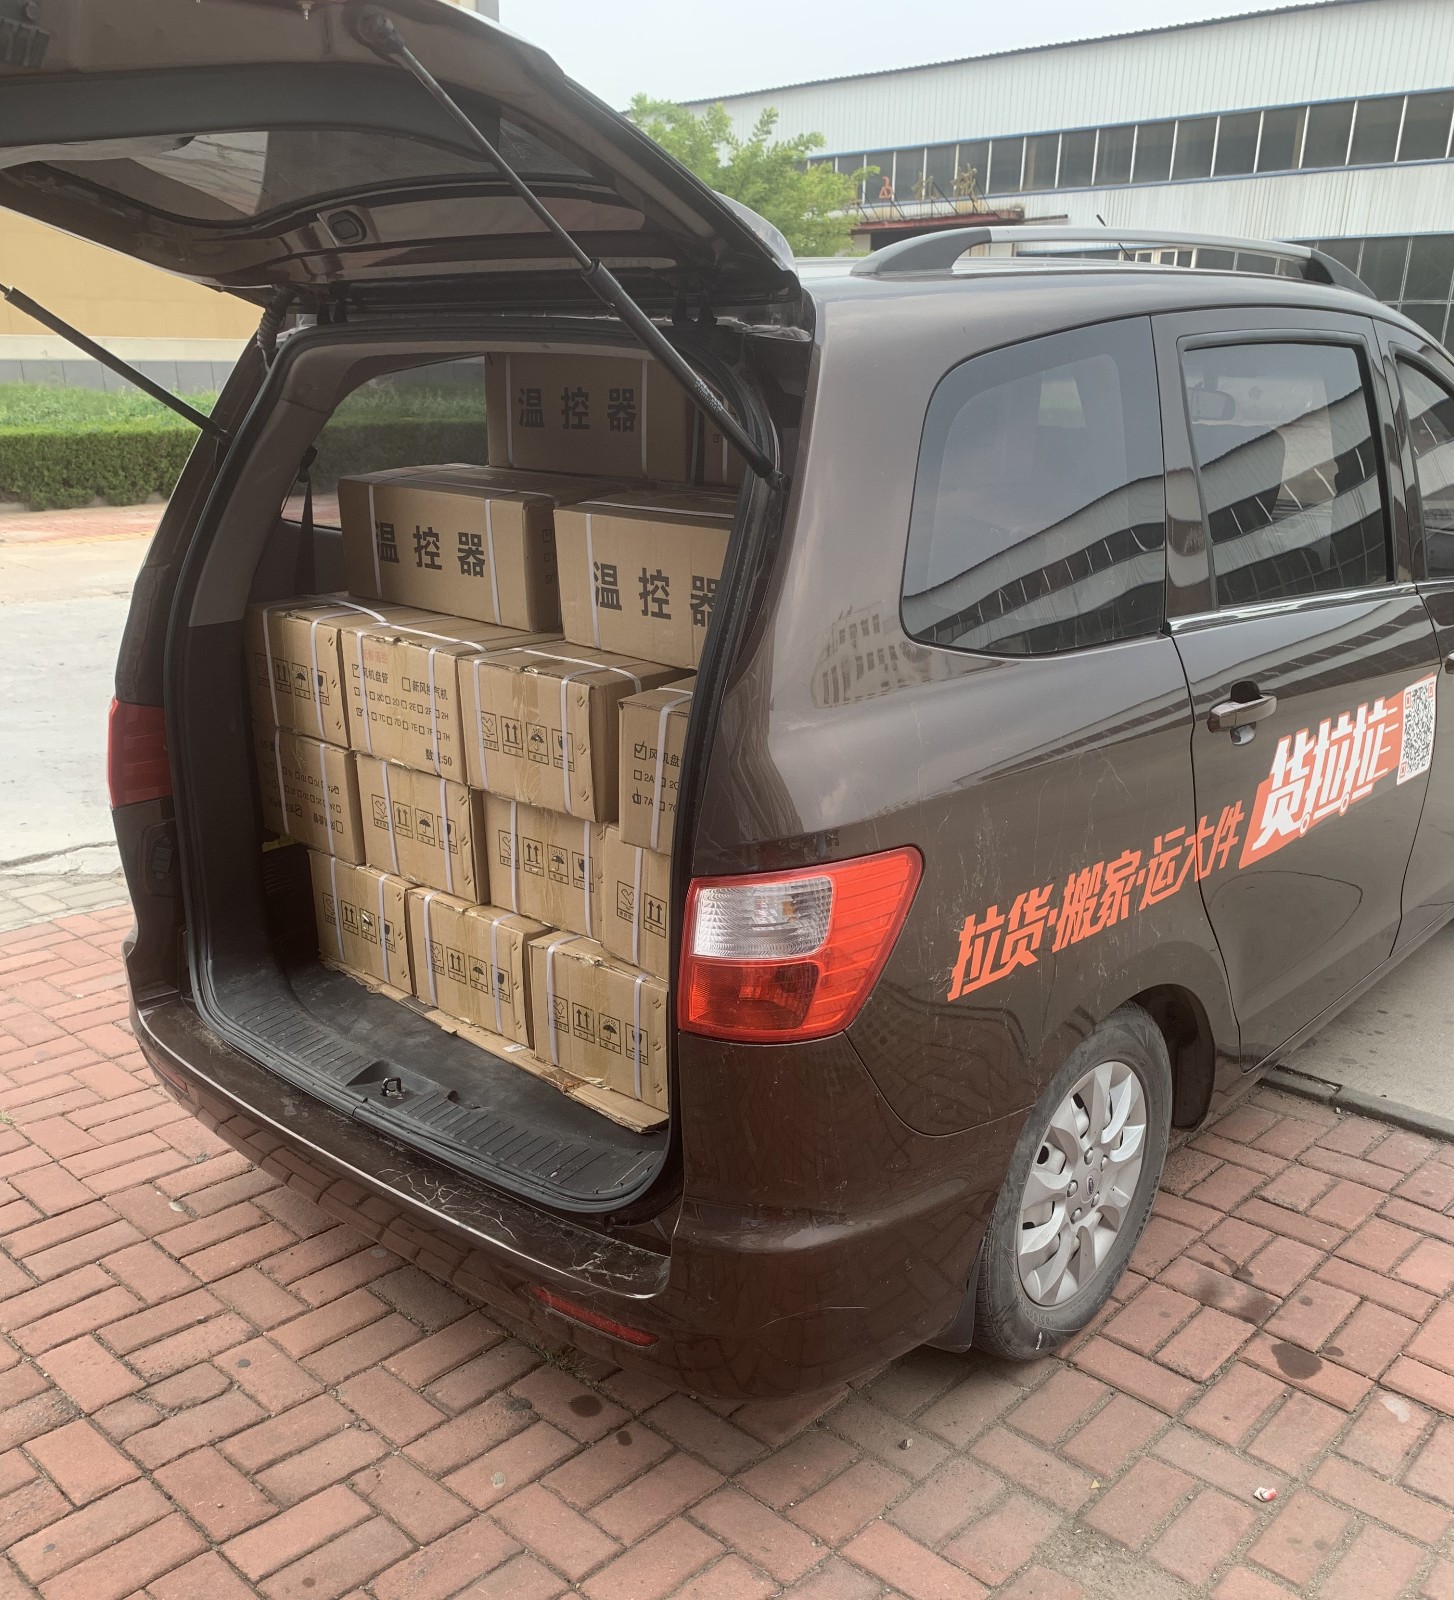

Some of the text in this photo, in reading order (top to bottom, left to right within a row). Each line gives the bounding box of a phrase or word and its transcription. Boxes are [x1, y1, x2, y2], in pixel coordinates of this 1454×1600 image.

[518, 386, 637, 432] 温控器
[375, 520, 486, 577] 温控器
[593, 560, 720, 627] 温控器
[441, 711, 449, 720] 2H
[442, 732, 450, 741] 7H
[425, 748, 453, 766] 数:50
[648, 748, 681, 767] 风机盘
[1252, 699, 1389, 851] 货拉拉
